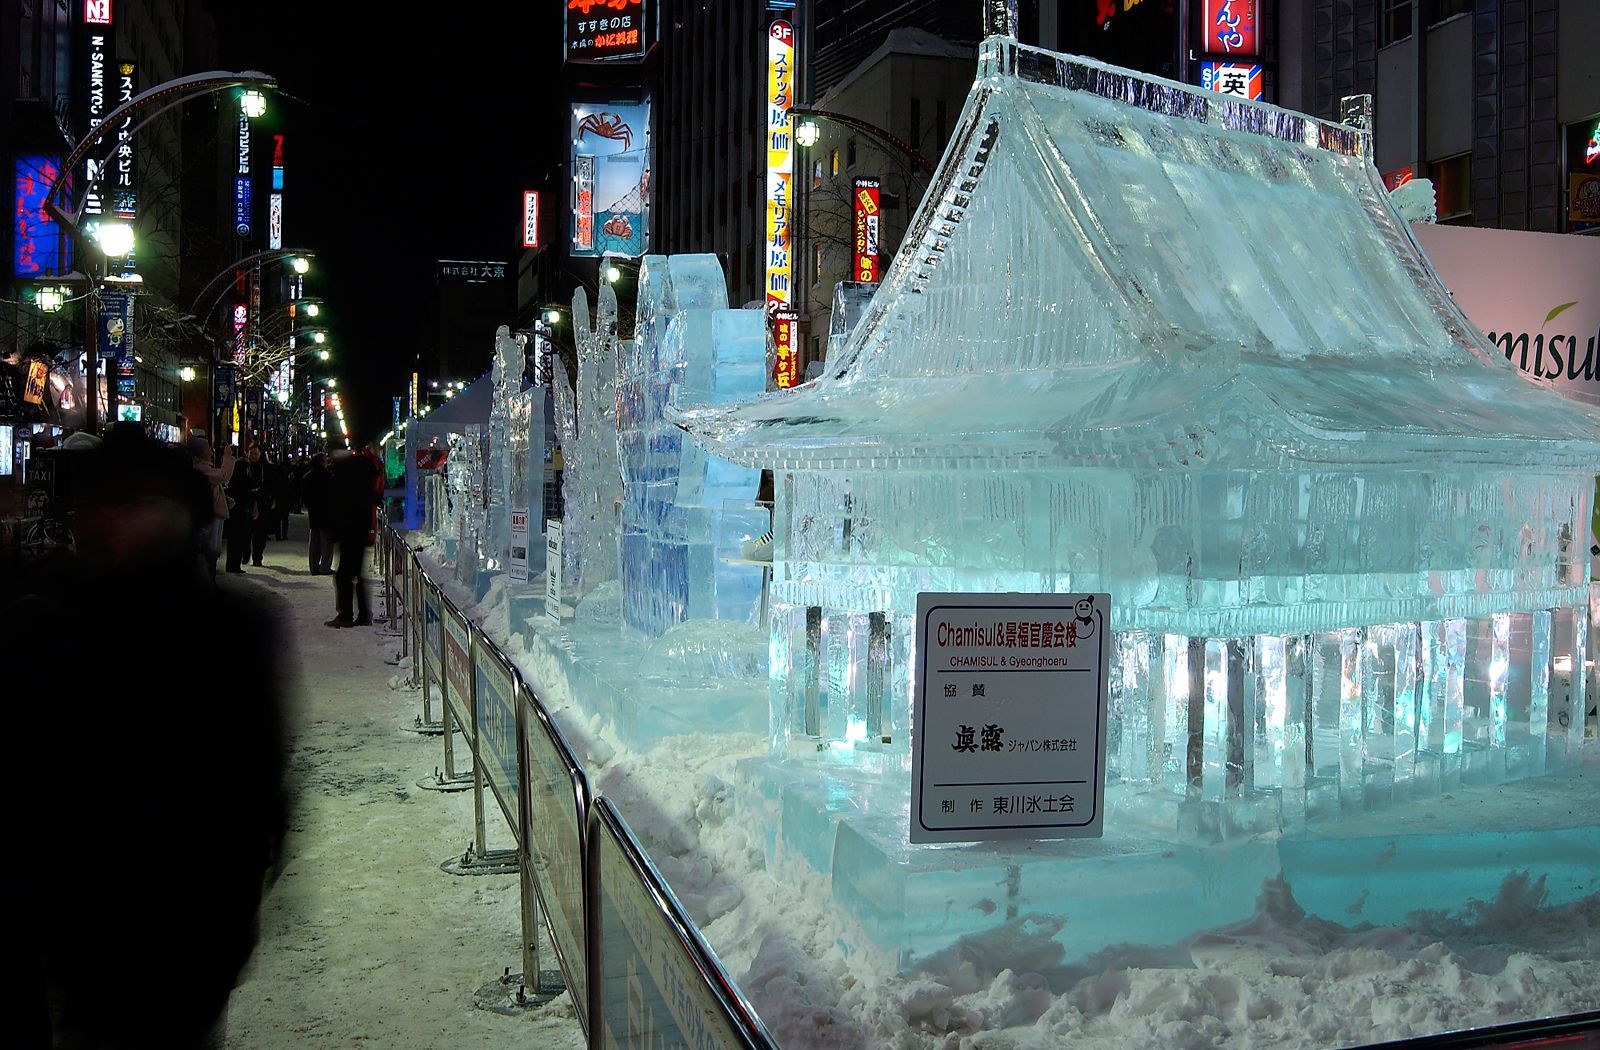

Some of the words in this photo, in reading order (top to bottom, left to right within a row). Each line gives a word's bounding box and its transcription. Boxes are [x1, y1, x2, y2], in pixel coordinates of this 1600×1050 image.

[577, 15, 632, 34] すすきの店
[772, 25, 791, 39] 3F
[1216, 0, 1244, 52] んや
[1222, 73, 1246, 95] 英
[118, 77, 133, 186] ススノ中央ビル
[29, 470, 51, 481] TAXI
[950, 656, 998, 666] CHAMISUL
[1001, 656, 1006, 666] &
[1009, 656, 1068, 668] Gyeonghoeru
[1008, 739, 1077, 752] ジャパン株式会社
